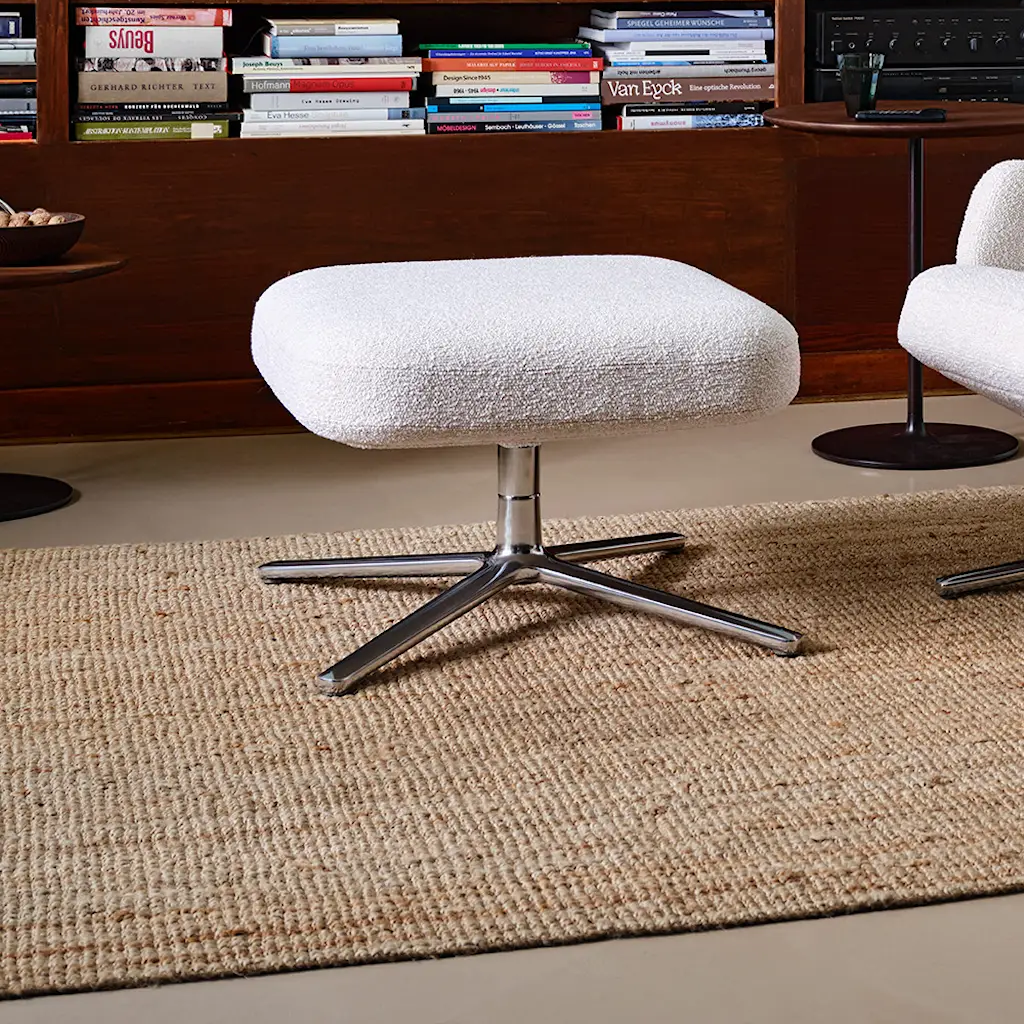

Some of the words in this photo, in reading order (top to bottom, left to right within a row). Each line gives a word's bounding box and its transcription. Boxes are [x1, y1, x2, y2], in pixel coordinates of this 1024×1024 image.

[109, 28, 154, 53] Beuys
[252, 80, 290, 90] Hofmann
[332, 80, 355, 89] Opus
[608, 81, 640, 96] Van
[643, 79, 682, 99] Eyck
